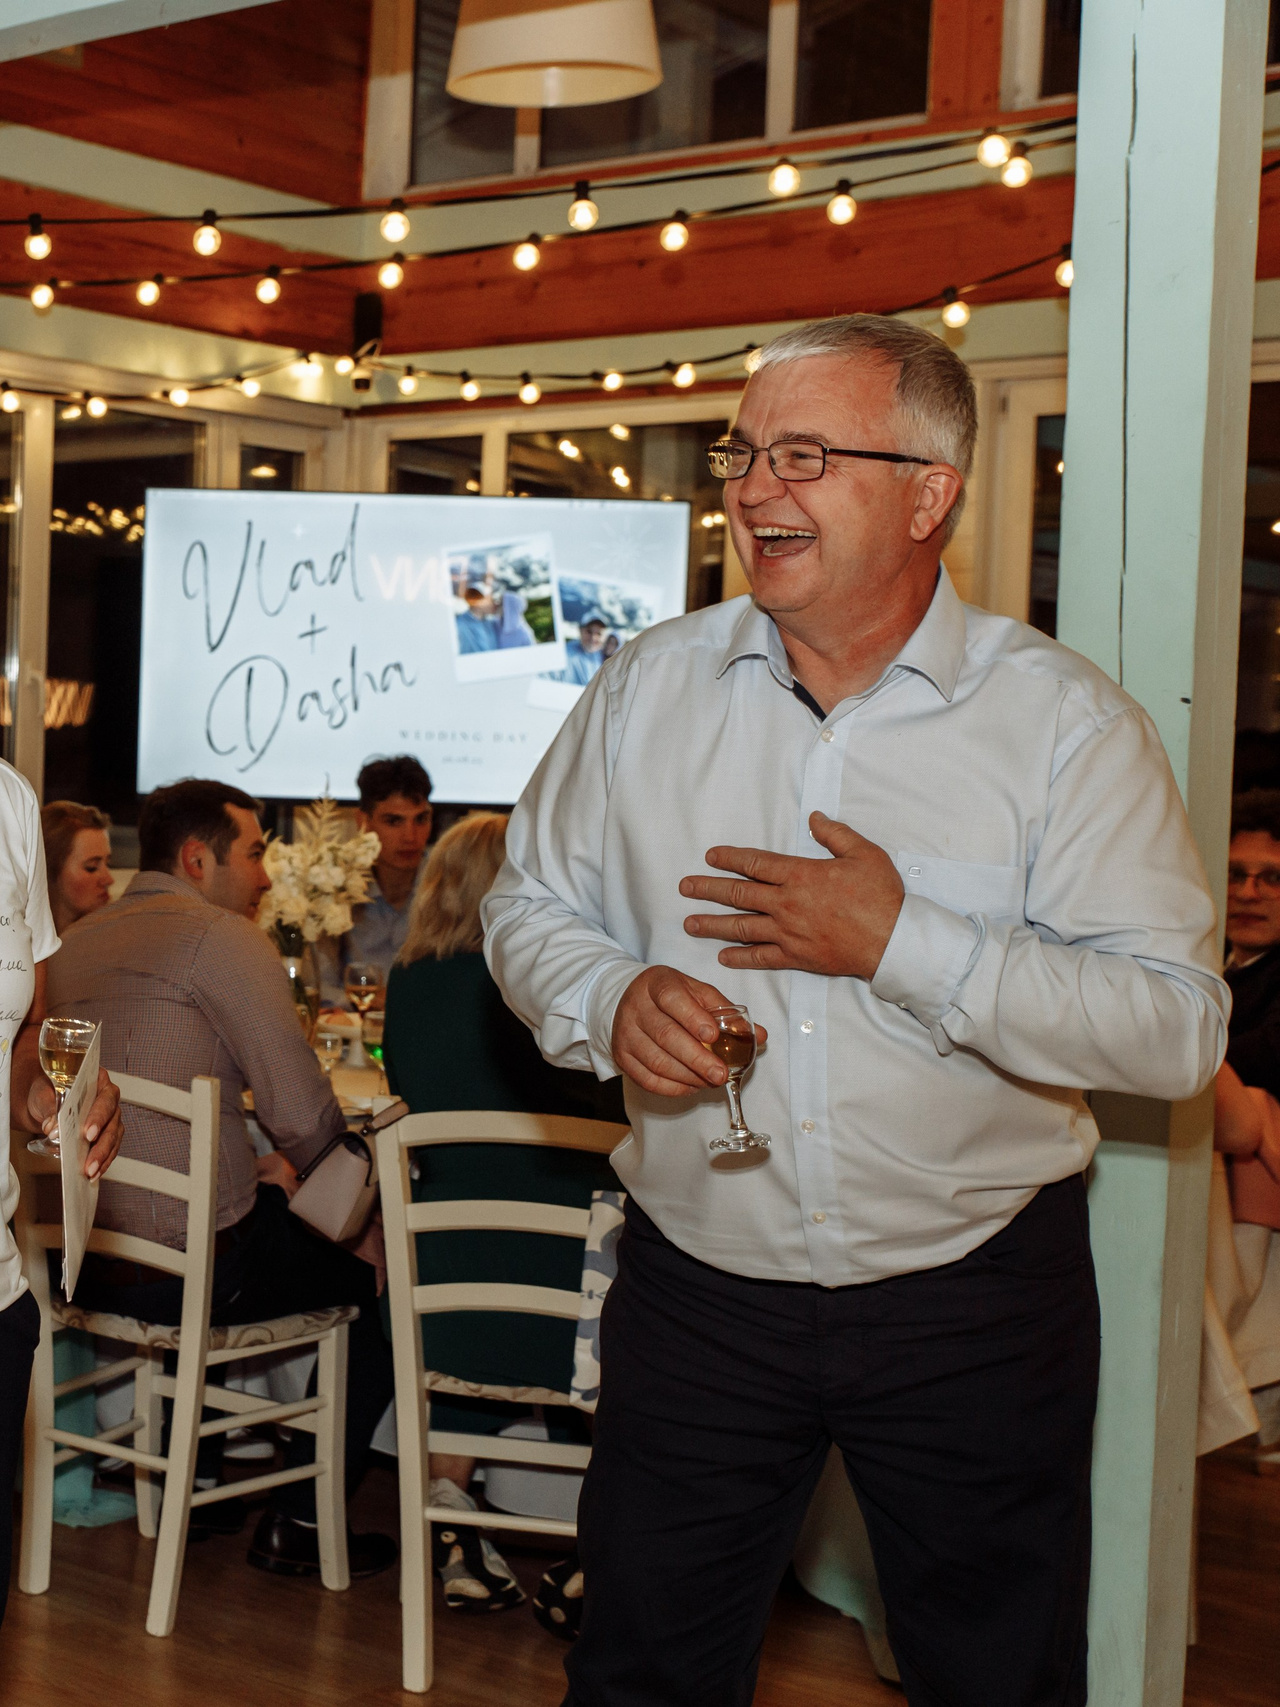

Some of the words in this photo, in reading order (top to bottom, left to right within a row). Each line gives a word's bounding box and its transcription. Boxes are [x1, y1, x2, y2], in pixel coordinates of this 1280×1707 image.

[182, 503, 363, 652] Vlad
[298, 613, 328, 653] +
[206, 645, 417, 772] Dasha
[399, 729, 483, 742] WEDDING
[492, 731, 527, 743] DAY
